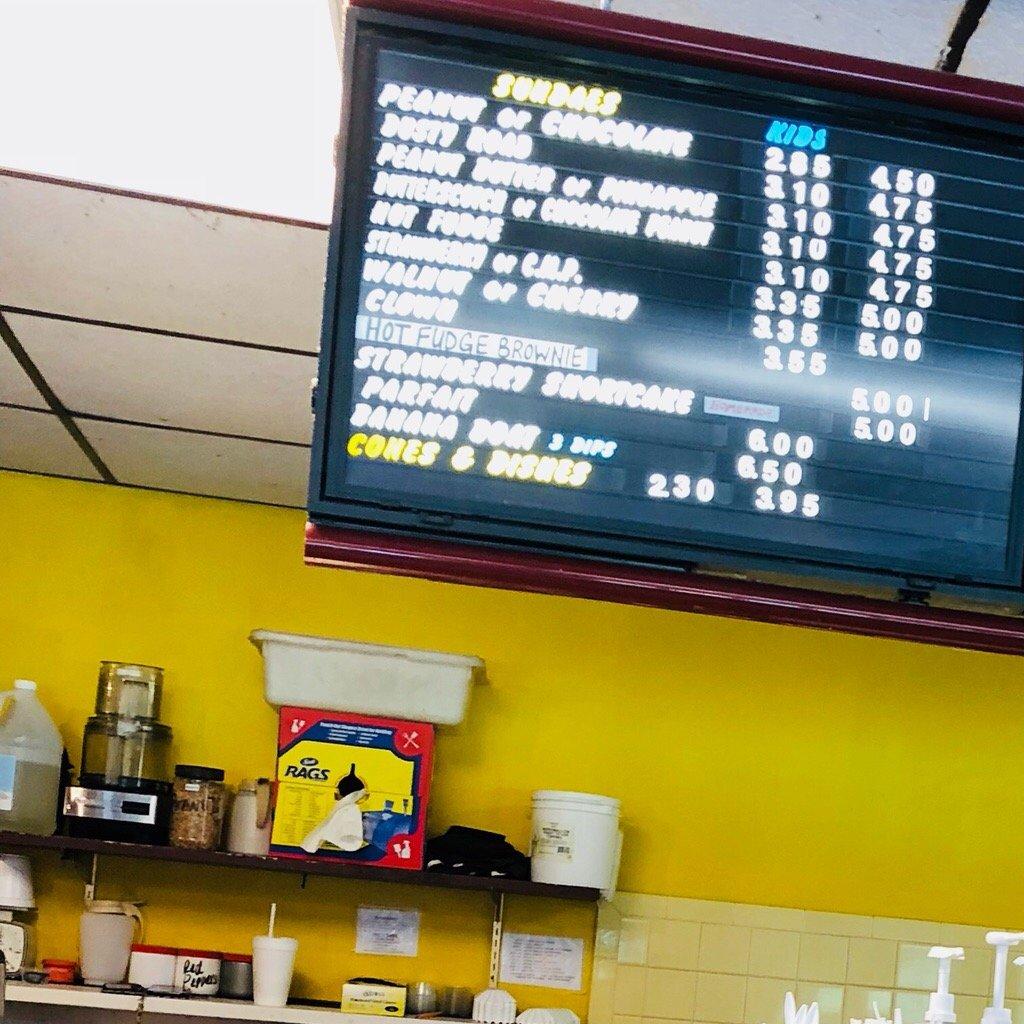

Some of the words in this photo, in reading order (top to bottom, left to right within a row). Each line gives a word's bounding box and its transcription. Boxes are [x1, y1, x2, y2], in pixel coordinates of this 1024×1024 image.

[492, 71, 622, 116] SUNDAES
[377, 82, 488, 124] PEANUT
[541, 109, 694, 158] CHOCOLATE
[380, 112, 460, 148] DUSTY
[466, 126, 533, 160] ROAD
[766, 120, 827, 150] KIDS
[376, 142, 466, 178] PEANUT
[370, 200, 420, 230] HOT
[427, 208, 504, 244] FUDGE
[362, 258, 474, 296] WALNUT
[526, 280, 641, 322] CHERRY
[365, 288, 459, 323] CLOWN
[366, 318, 407, 346] HOT
[416, 331, 488, 356] FUDGE
[498, 340, 585, 368] BROWNIE
[353, 345, 533, 394] STRAWBERRY
[541, 371, 696, 416] SHORTCAKE
[361, 375, 479, 414] PARFAIT
[349, 403, 459, 439] BANANA
[468, 417, 541, 451] BOAT
[548, 432, 565, 452] 3
[570, 436, 618, 459] DIPS
[347, 432, 441, 467] CONES
[450, 445, 476, 472] &
[486, 449, 592, 487] DISHES
[285, 765, 330, 781] RAGS
